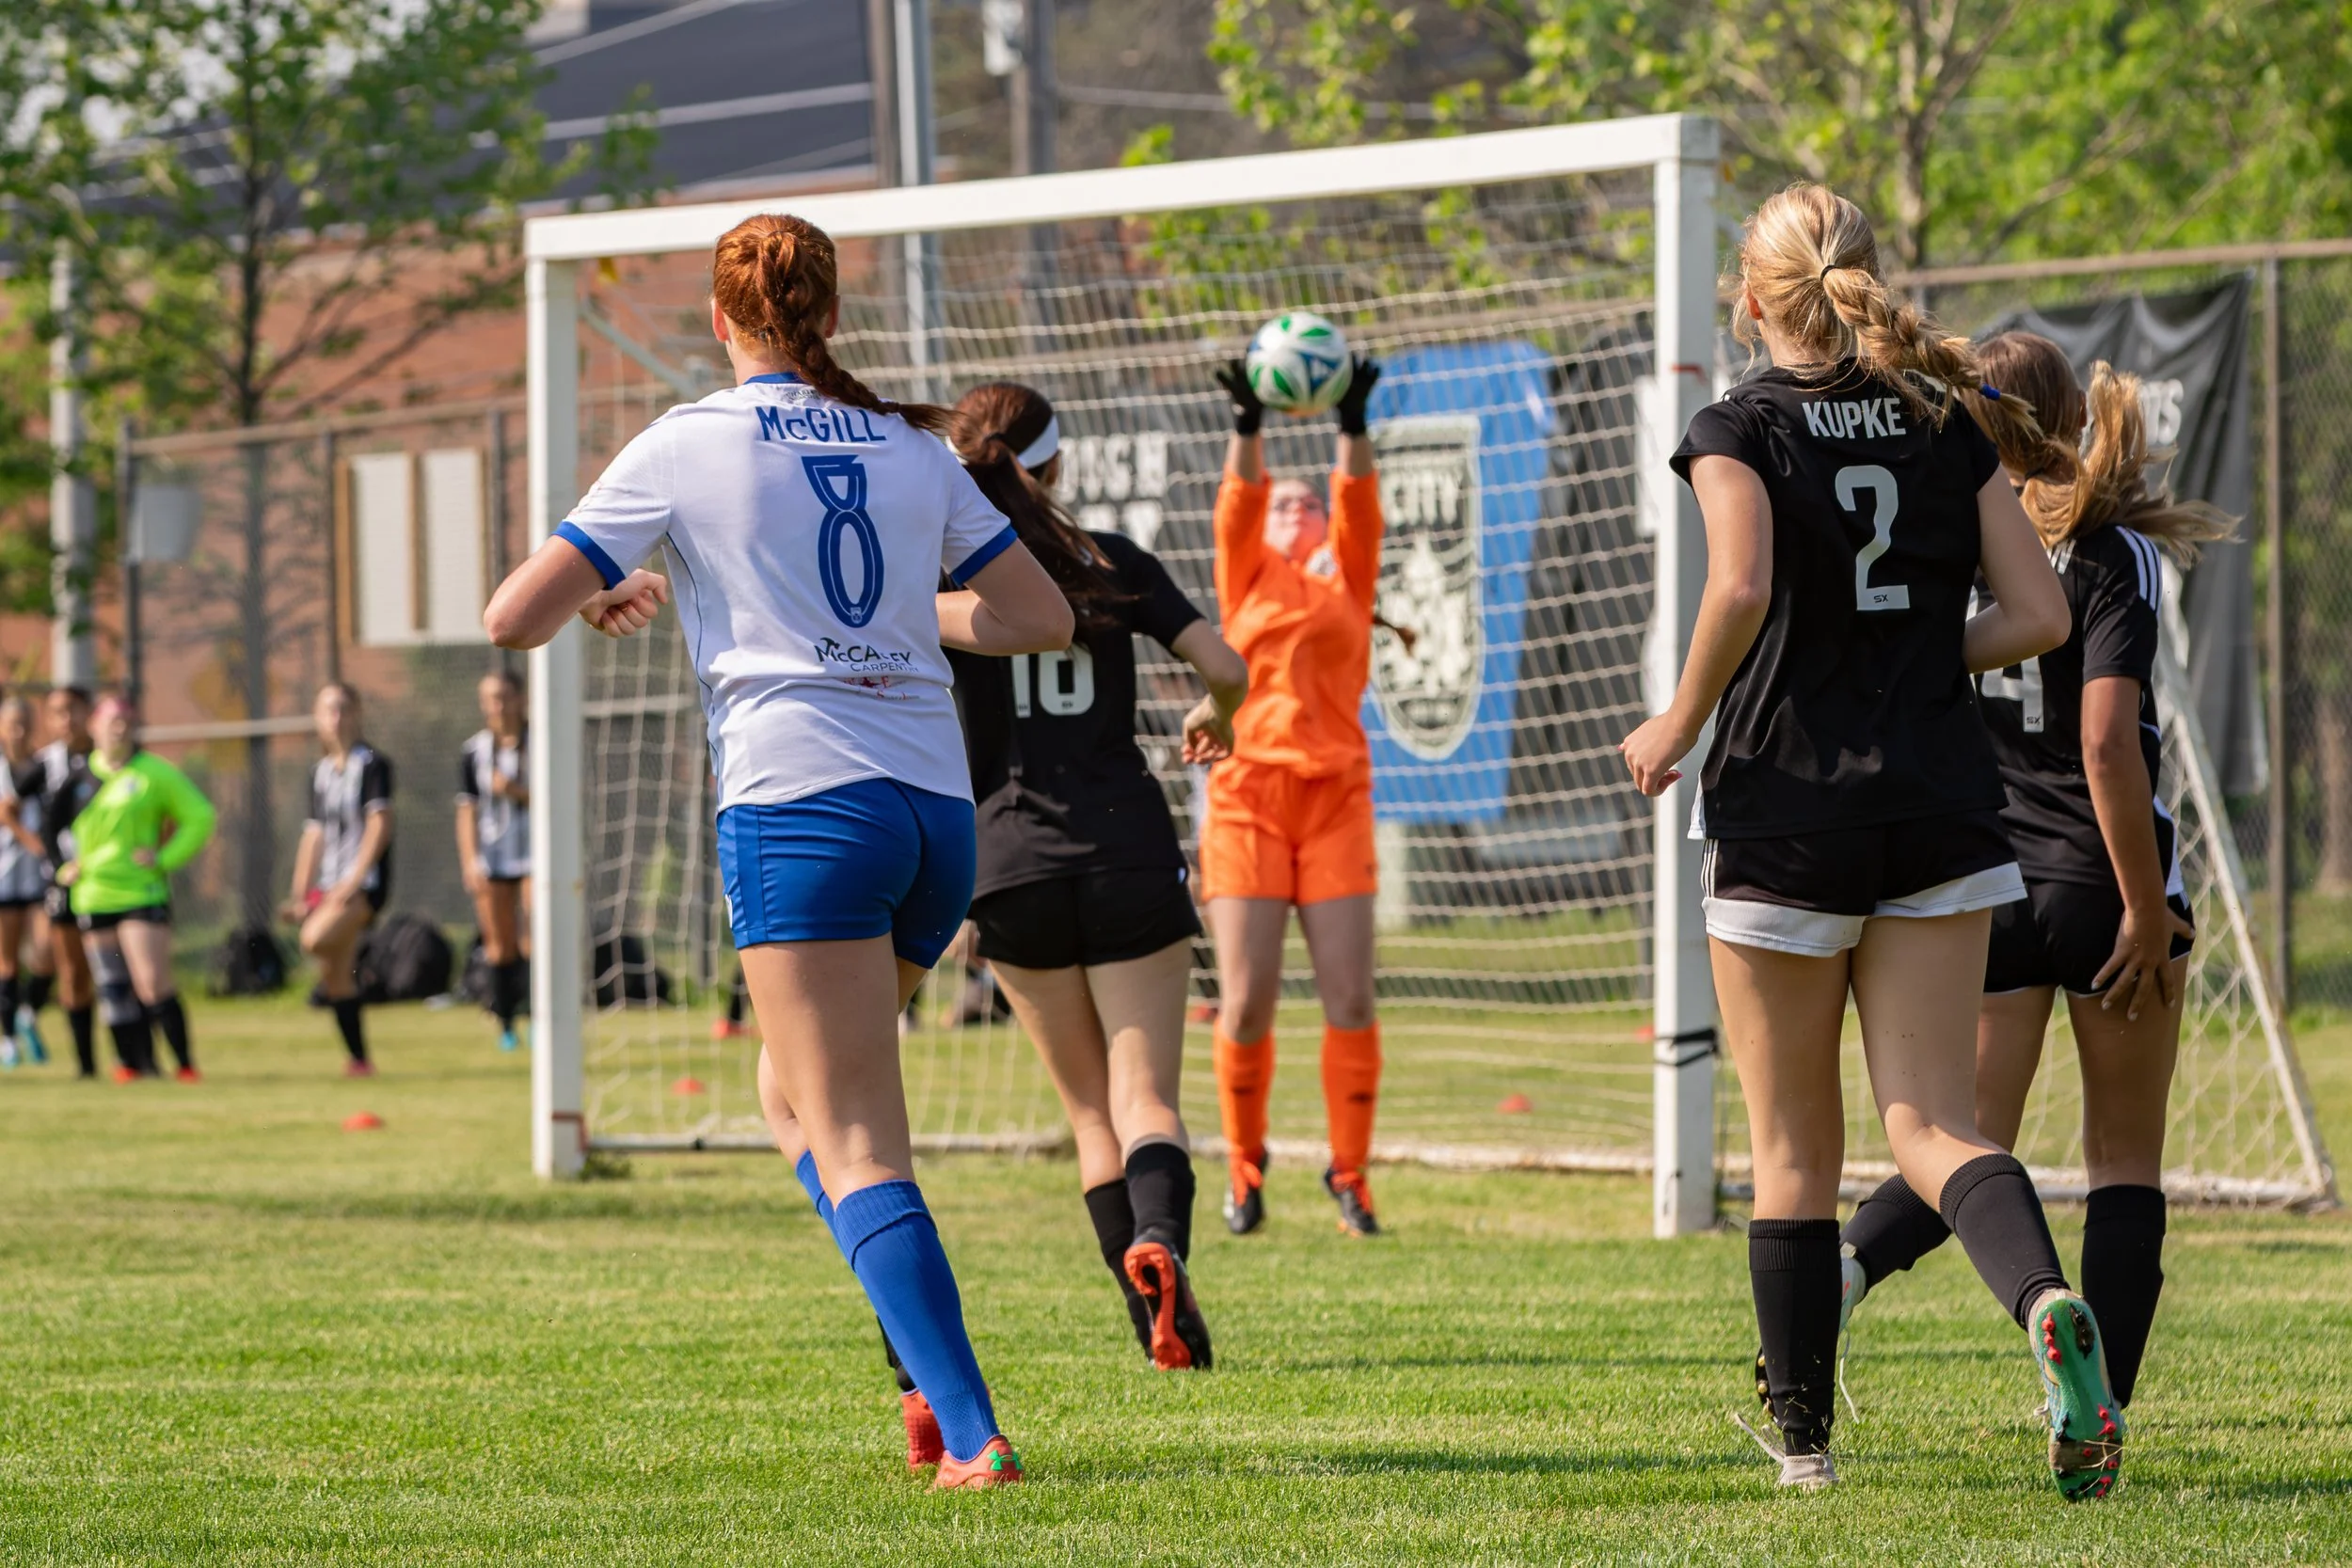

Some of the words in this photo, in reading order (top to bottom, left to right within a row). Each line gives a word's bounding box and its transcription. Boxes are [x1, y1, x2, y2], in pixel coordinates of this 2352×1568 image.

[755, 405, 886, 442] McGILL
[1803, 398, 1906, 439] KUPKE
[801, 454, 884, 628] 8
[1836, 465, 1910, 610] 2
[1874, 594, 1888, 603] SX
